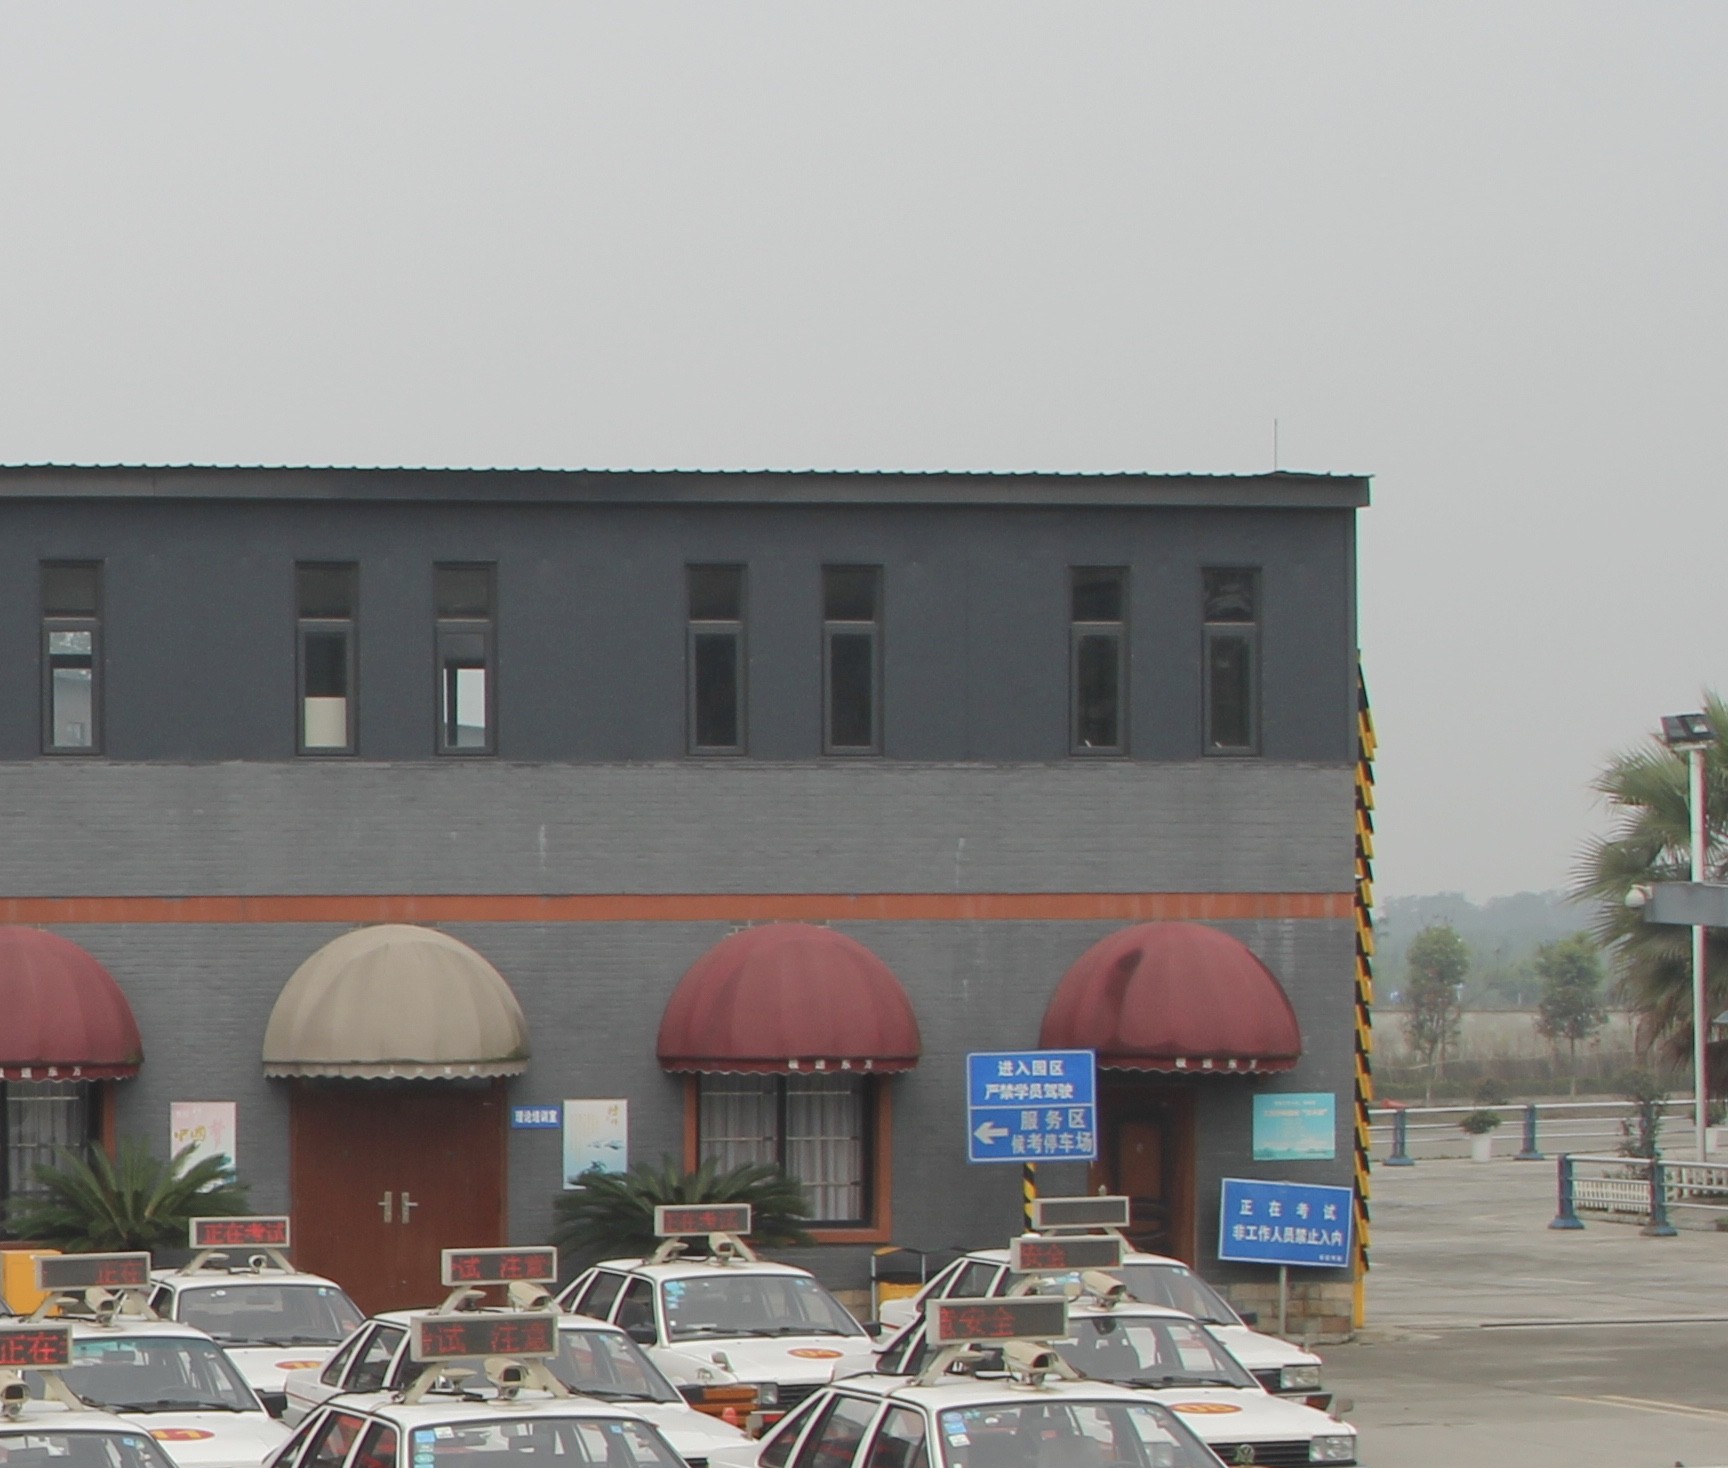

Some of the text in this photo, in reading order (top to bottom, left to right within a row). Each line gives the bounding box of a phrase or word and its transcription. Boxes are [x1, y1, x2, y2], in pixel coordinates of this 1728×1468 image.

[998, 1060, 1063, 1076] 进入园区
[985, 1083, 1073, 1100] 严禁学员驾驶
[1020, 1108, 1085, 1130] 服务区
[1011, 1131, 1093, 1154] 候考停车场
[1239, 1199, 1337, 1221] 正在考试
[1233, 1224, 1343, 1246] 非工作人员禁止入内
